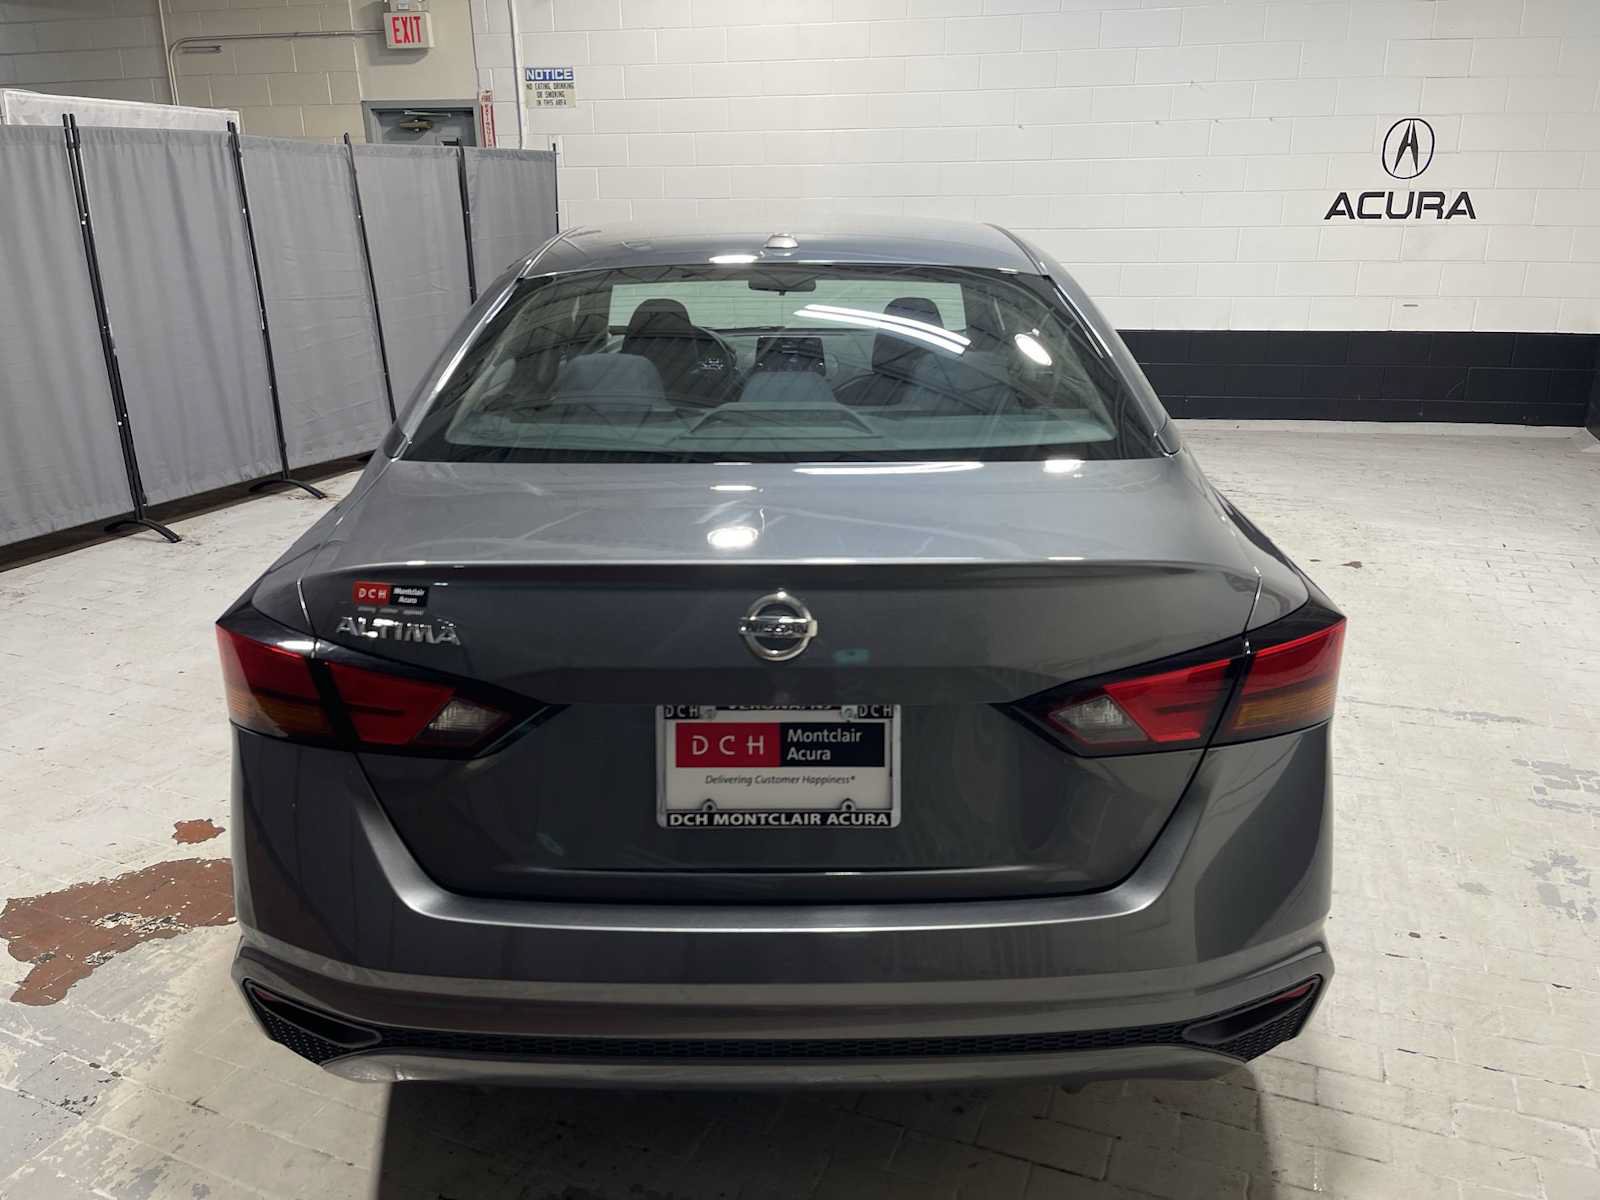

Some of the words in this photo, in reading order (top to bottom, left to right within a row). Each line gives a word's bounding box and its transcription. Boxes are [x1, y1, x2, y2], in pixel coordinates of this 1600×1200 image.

[391, 16, 422, 44] EXIT
[526, 69, 573, 80] NOTICE
[526, 82, 533, 90] NO
[553, 82, 575, 90] DRINKING
[481, 94, 492, 102] FIRE
[536, 98, 542, 106] IN
[543, 98, 554, 106] THIS
[555, 98, 568, 106] AREA
[1324, 191, 1477, 220] ACURA
[358, 587, 387, 600] DCH
[336, 616, 461, 646] ALTIMA
[665, 705, 699, 718] DCH
[859, 705, 893, 718] DCH
[787, 728, 863, 743] Montclair
[691, 735, 765, 756] DCH
[787, 747, 831, 761] Acura
[705, 775, 753, 787] Delivering
[755, 775, 800, 785] Customer
[669, 813, 709, 826] DCH
[713, 813, 822, 826] MONTCLAIR
[826, 813, 889, 826] ACURA
